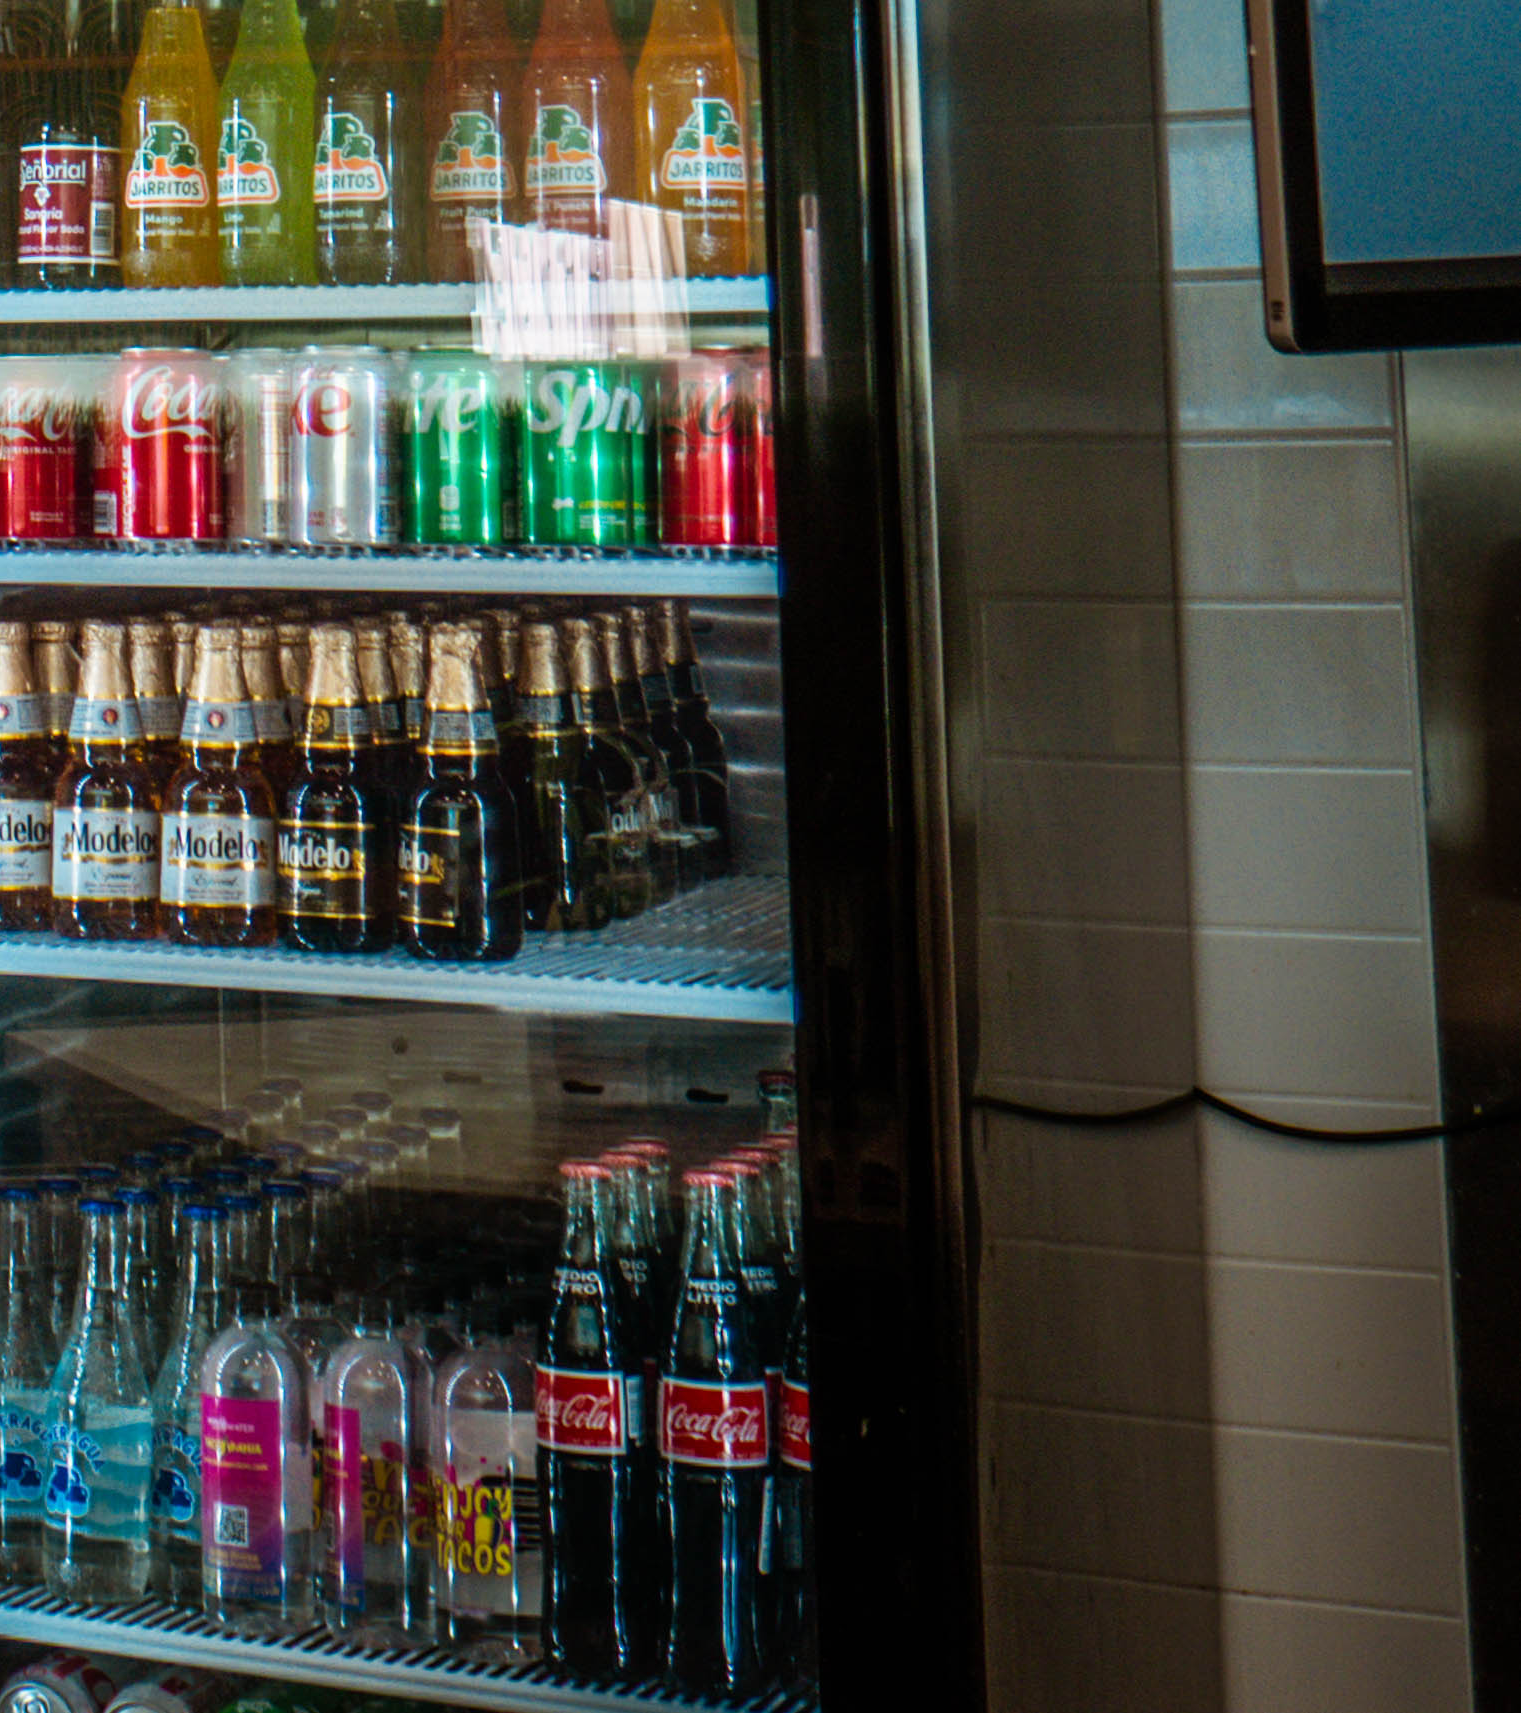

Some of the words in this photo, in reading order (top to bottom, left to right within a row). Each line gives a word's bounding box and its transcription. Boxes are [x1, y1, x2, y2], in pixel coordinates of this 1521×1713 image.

[131, 180, 200, 197] JARRITOS
[71, 822, 153, 854] Modelo
[175, 826, 258, 860] Modelo
[687, 1278, 736, 1294] MEDIO
[687, 1291, 738, 1307] LITRO
[669, 1400, 763, 1445] Coca-Cola
[436, 1533, 512, 1577] TACOS
